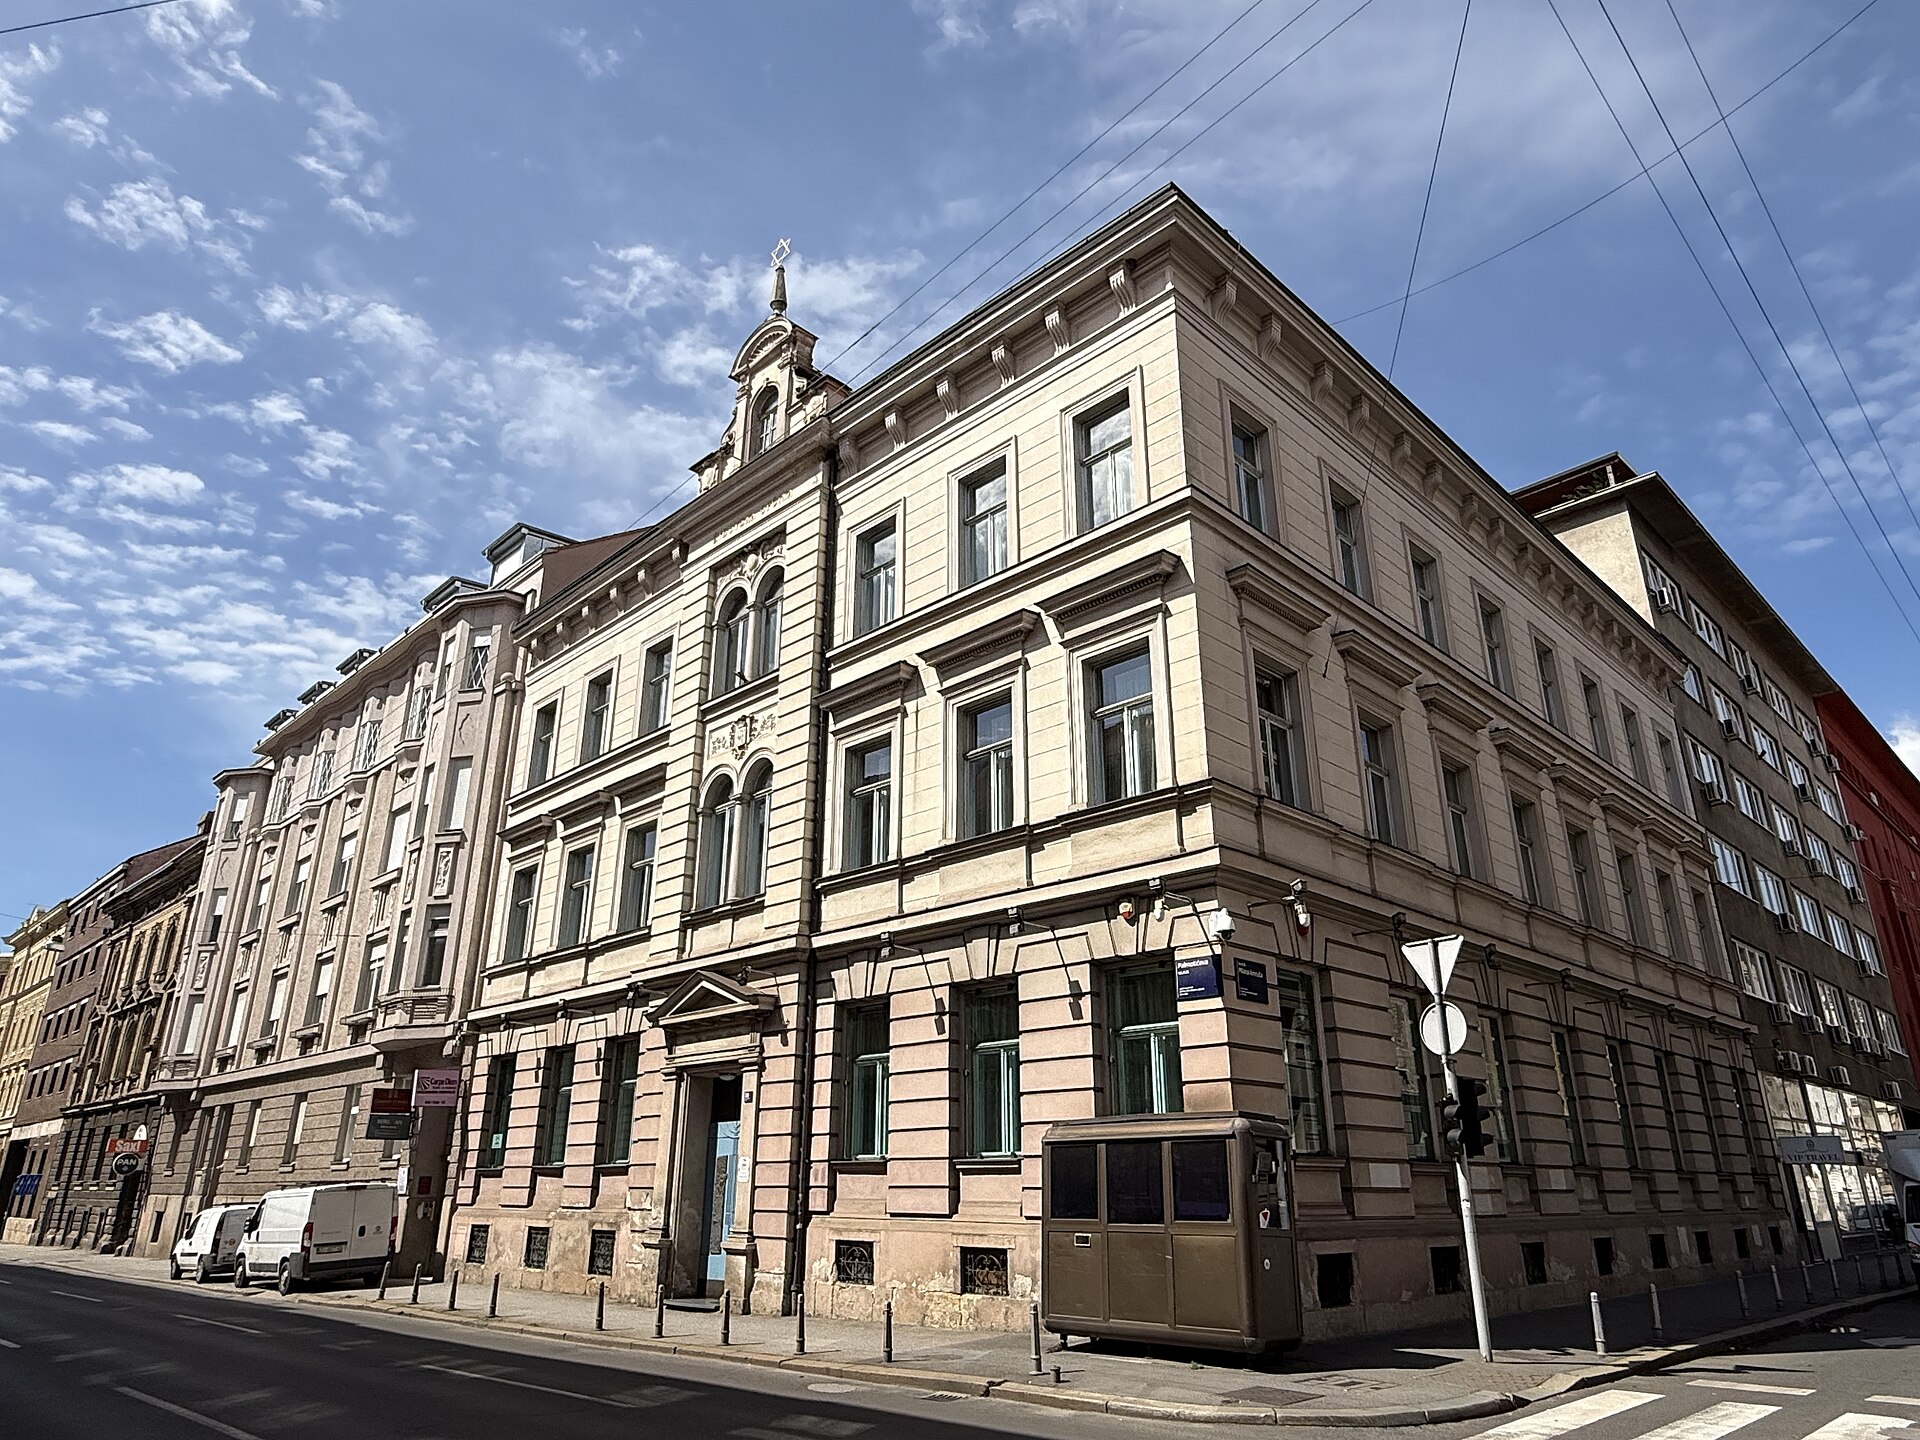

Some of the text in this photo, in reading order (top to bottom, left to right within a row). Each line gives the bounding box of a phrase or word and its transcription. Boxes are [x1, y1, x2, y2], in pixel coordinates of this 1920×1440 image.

[1787, 1153, 1841, 1162] VIP TRAVEL
[116, 1158, 137, 1166] PAN
